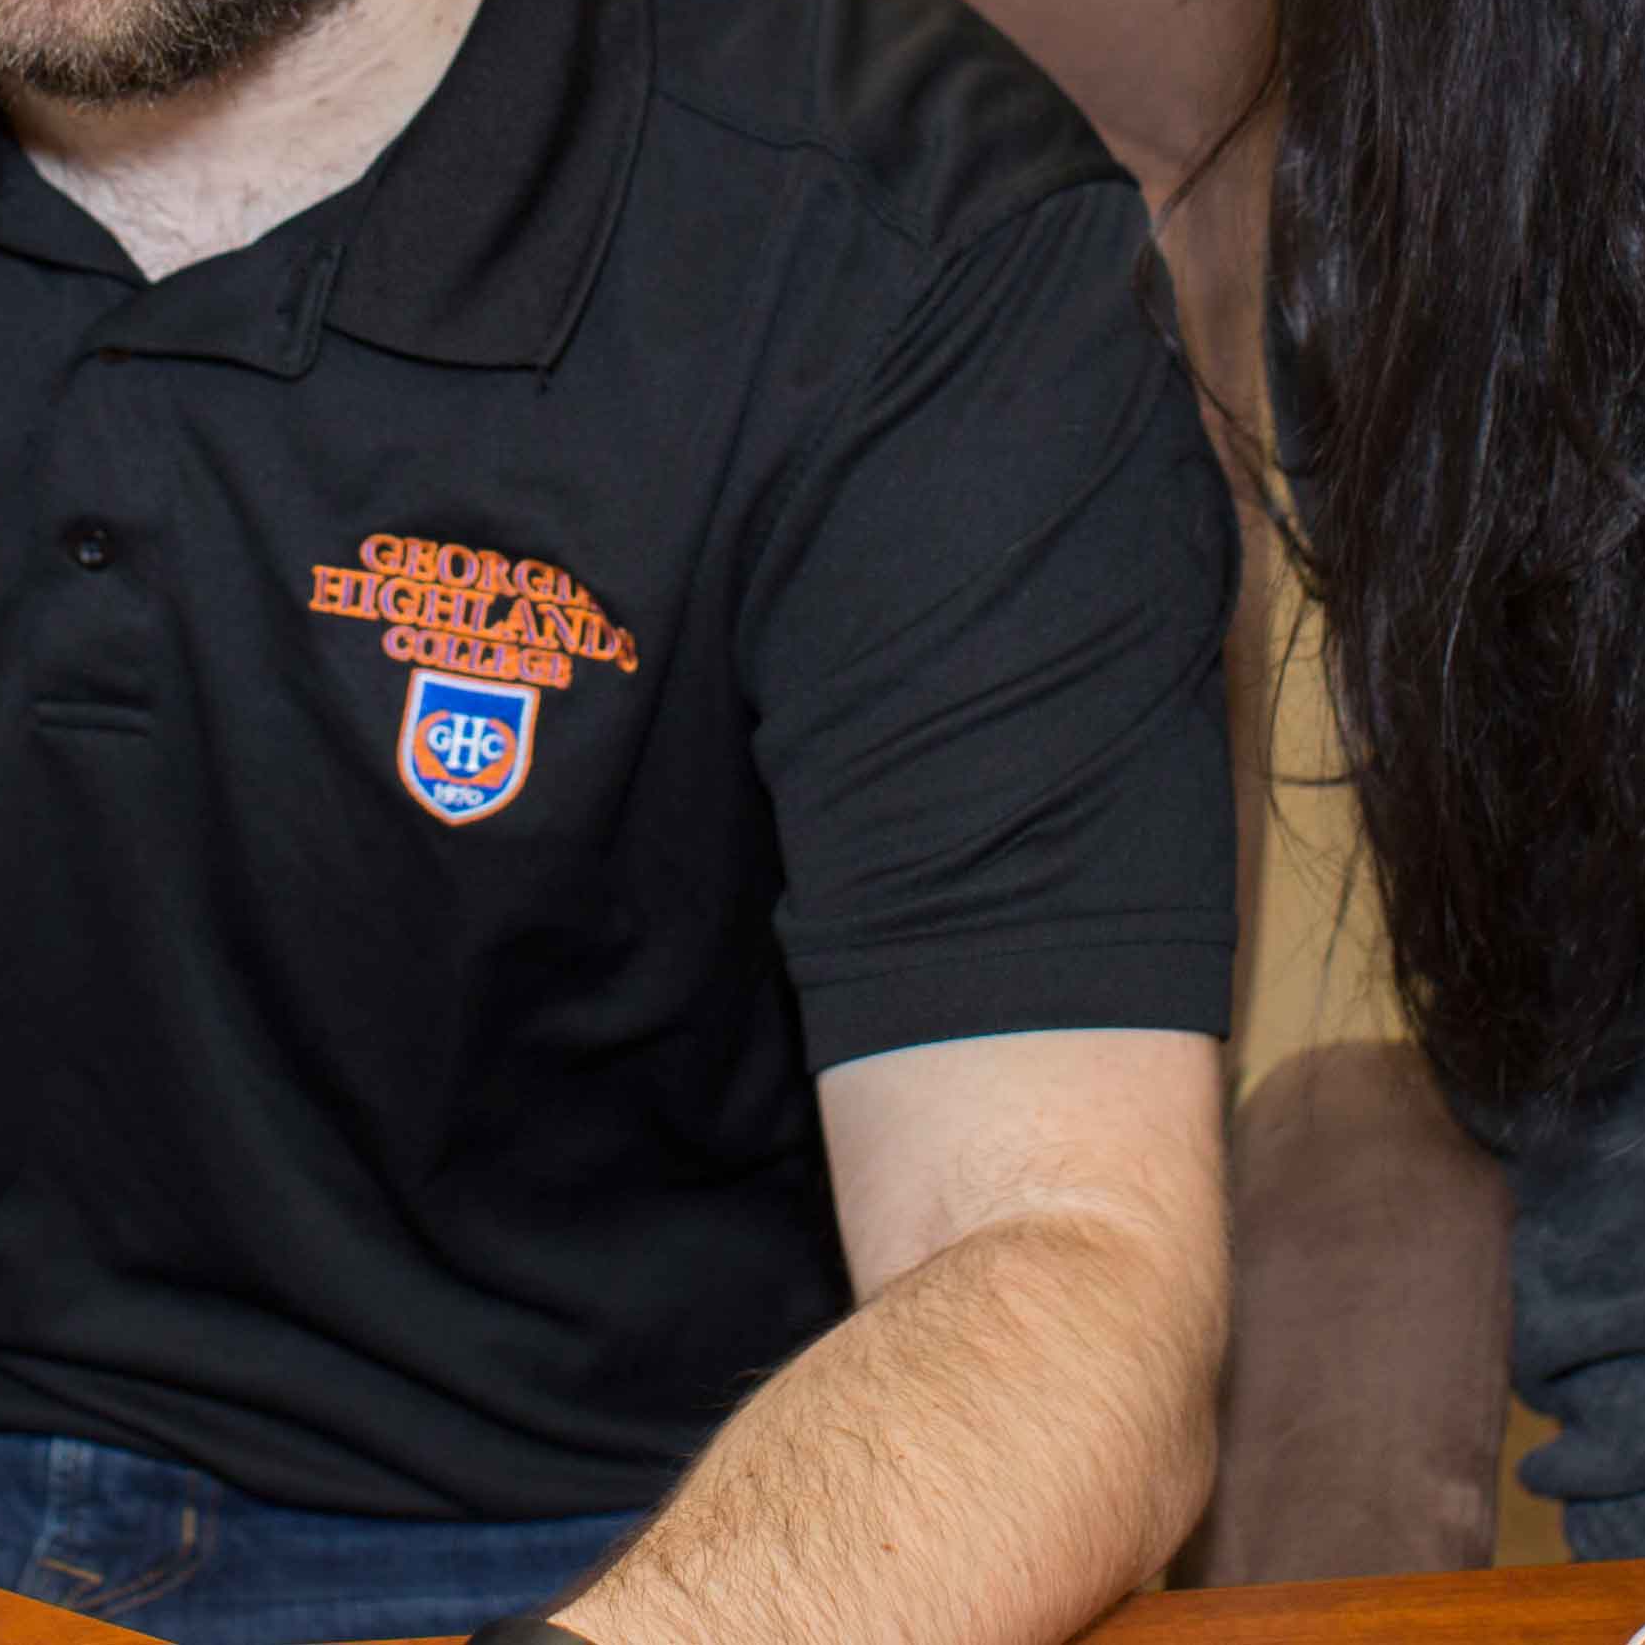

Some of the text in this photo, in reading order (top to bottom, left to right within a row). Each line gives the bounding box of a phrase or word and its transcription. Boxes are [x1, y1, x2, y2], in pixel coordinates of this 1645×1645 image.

[309, 564, 639, 673] HIGHLANDS
[382, 625, 573, 690] COLLEGE
[427, 712, 507, 772] GHC
